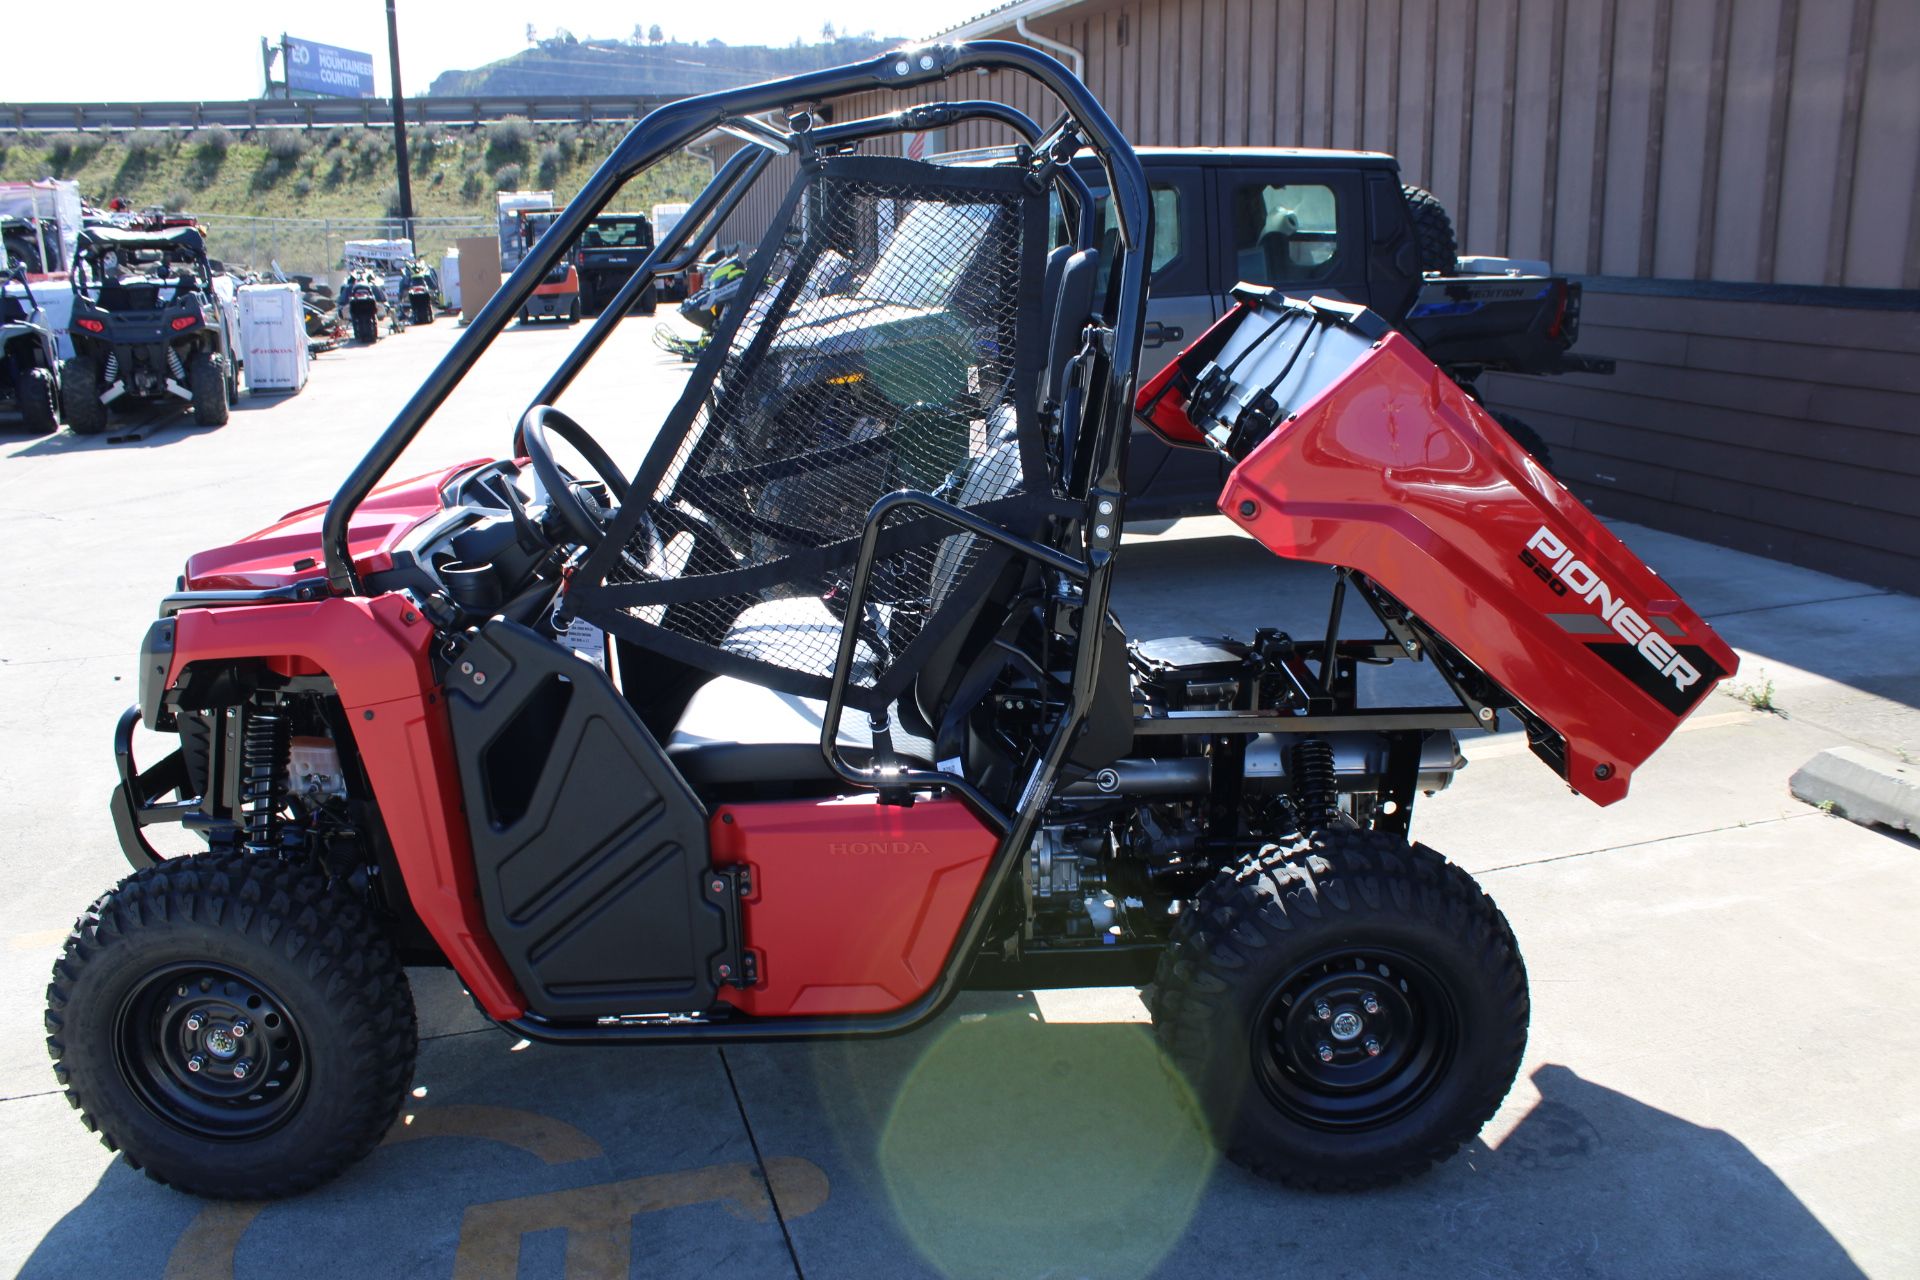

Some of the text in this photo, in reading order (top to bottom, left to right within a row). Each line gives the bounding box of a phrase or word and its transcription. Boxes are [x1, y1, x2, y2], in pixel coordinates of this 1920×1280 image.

[318, 54, 373, 77] MOUNTAINEER
[320, 68, 360, 89] COUNTRY!
[1518, 549, 1568, 597] 520
[1526, 525, 1702, 693] PIONEER
[828, 841, 931, 856] HONDA
